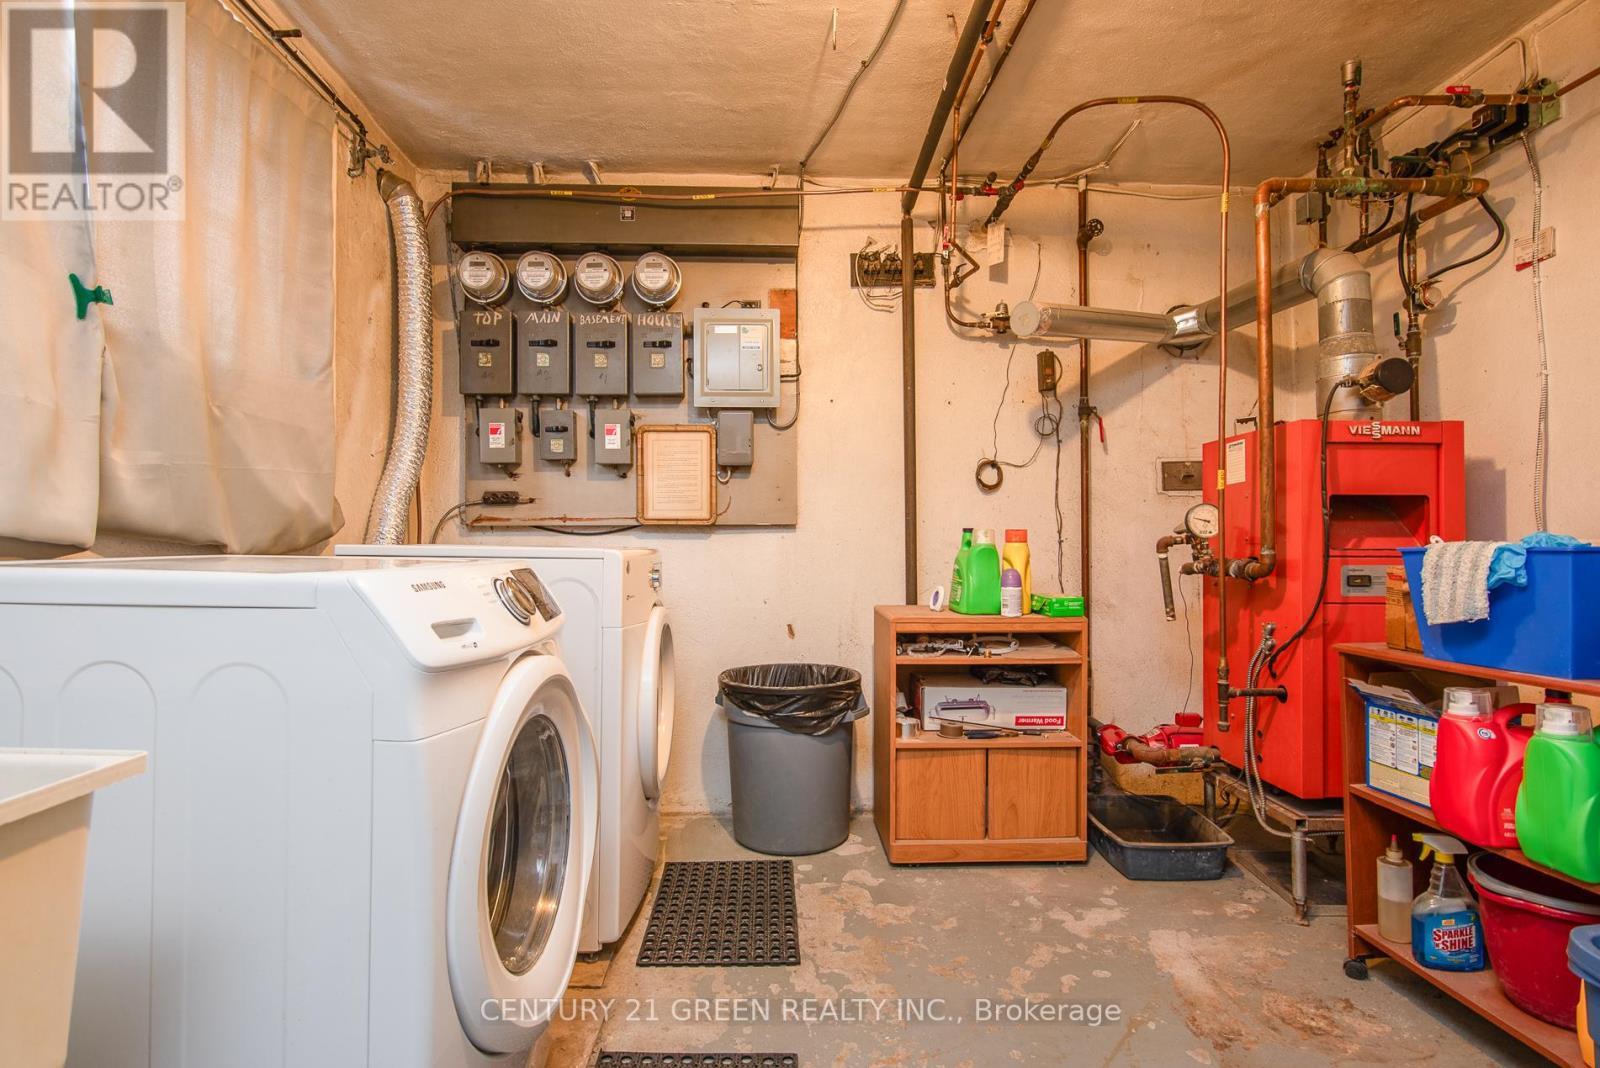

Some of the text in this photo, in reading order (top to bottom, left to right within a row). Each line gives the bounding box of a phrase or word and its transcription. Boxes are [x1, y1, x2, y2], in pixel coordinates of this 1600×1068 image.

[473, 311, 503, 326] TOP
[524, 311, 561, 324] MAIN
[579, 313, 626, 326] BASEMENT
[637, 314, 680, 327] HOUS
[1348, 421, 1421, 438] VIESSMANN
[411, 581, 446, 592] SAMSUNG
[1017, 717, 1062, 725] Food Warmer
[1432, 927, 1473, 942] SPARKLE
[1441, 937, 1474, 951] SHINE
